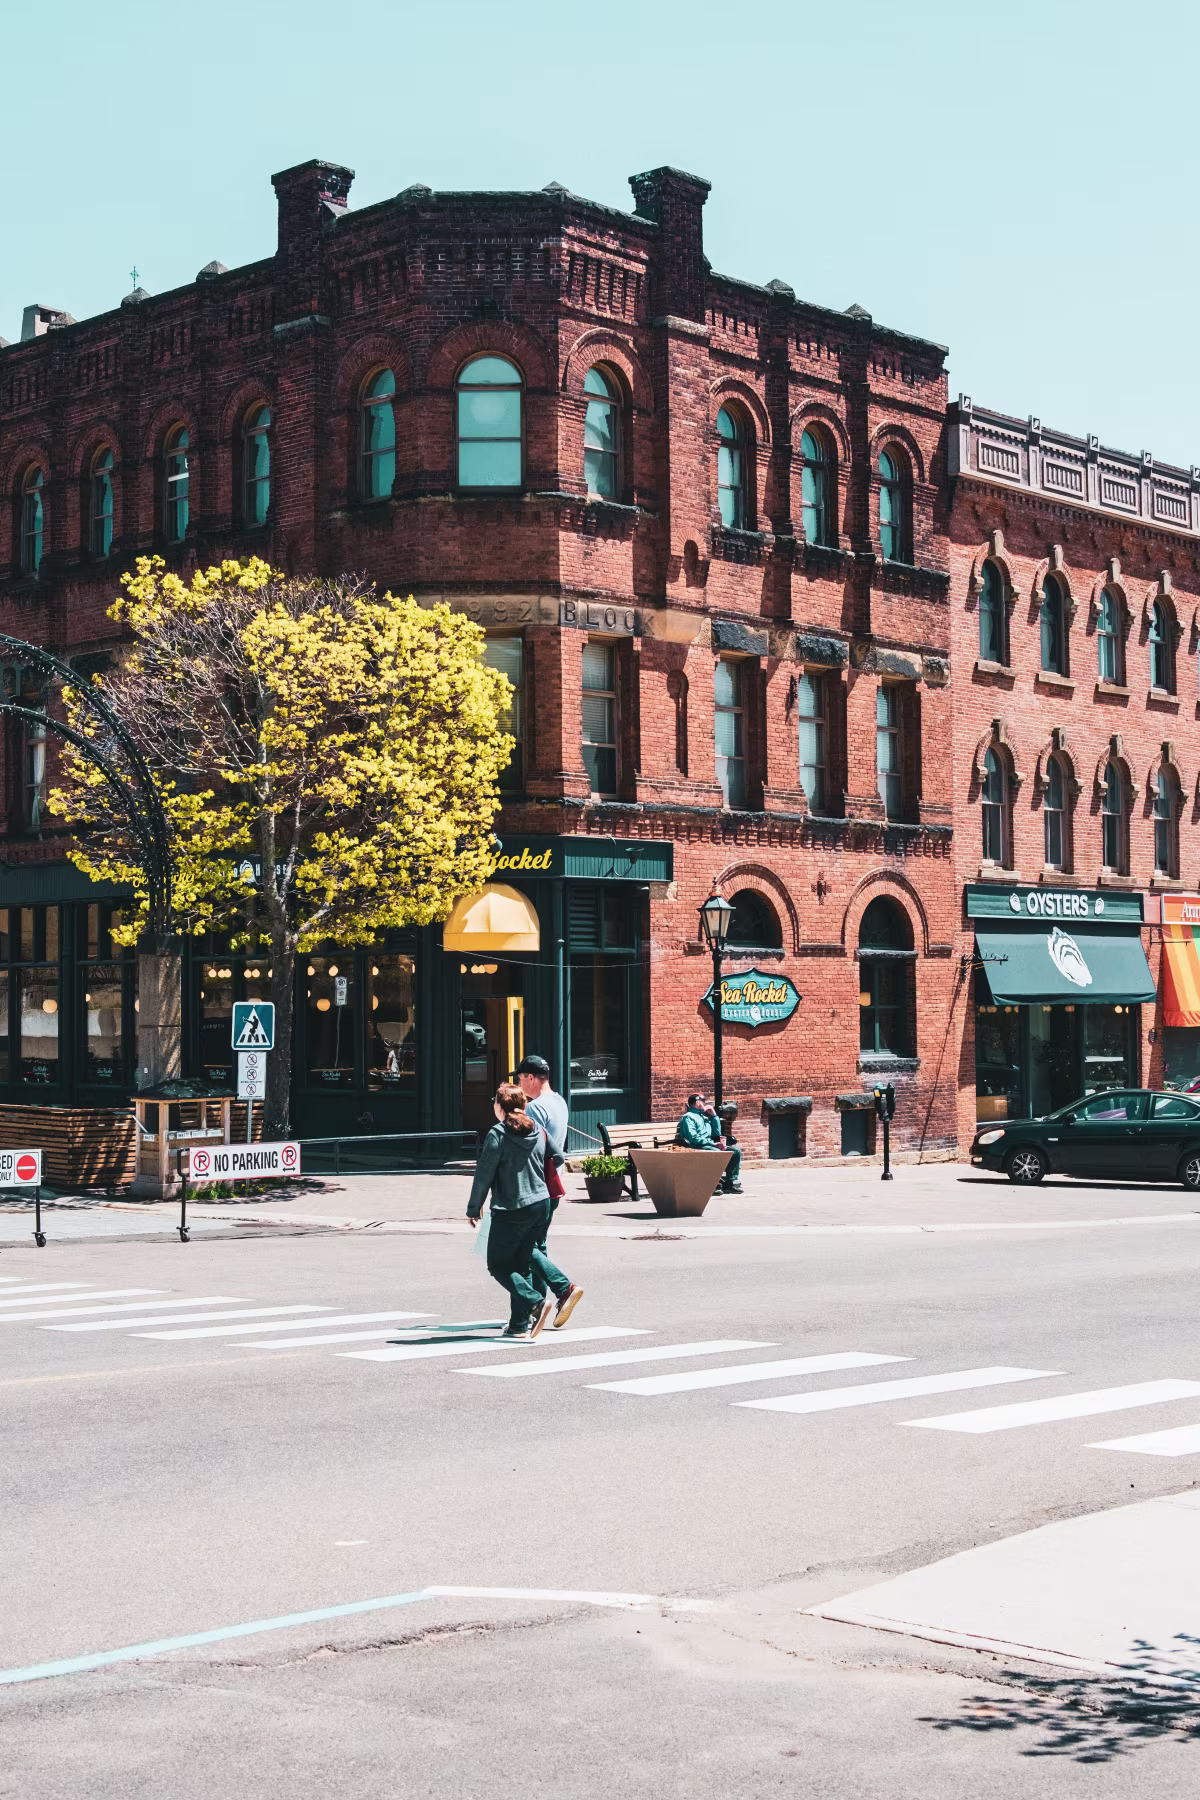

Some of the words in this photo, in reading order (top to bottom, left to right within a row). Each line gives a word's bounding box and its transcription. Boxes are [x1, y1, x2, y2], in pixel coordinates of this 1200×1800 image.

[564, 600, 655, 636] BLOCK
[1027, 892, 1089, 917] OYSTERS
[720, 981, 742, 1004] Sea
[743, 981, 788, 1003] Rocket
[214, 1154, 229, 1172] NO
[232, 1151, 278, 1171] PARKING
